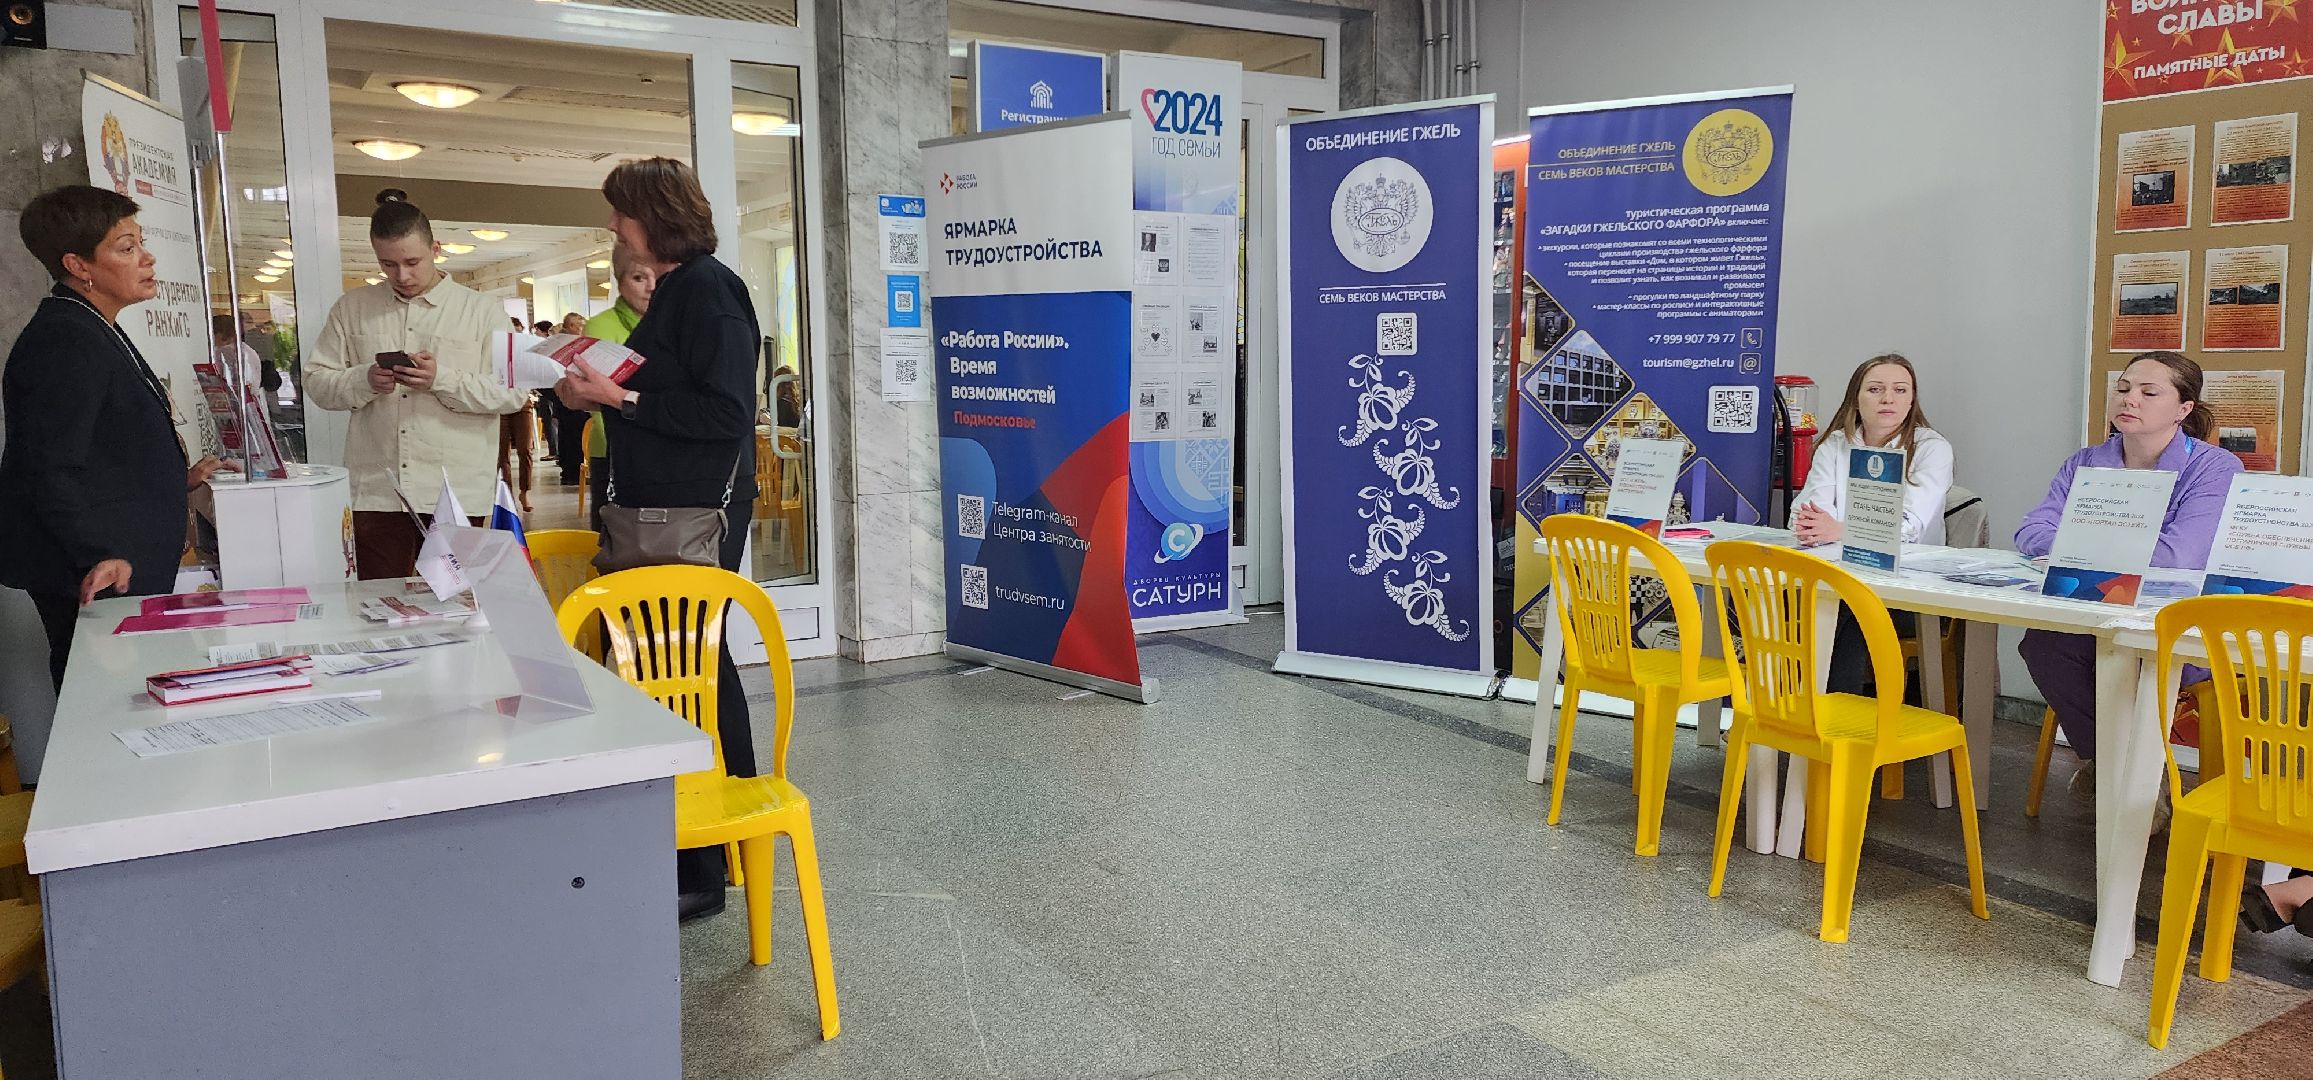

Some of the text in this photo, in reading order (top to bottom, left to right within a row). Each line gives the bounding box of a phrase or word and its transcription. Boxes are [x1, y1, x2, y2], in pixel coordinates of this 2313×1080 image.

[2157, 0, 2263, 35] СЛАВЫ
[2134, 46, 2286, 79] ПАМЯТНЫЕ ДАТЫ
[1153, 89, 1223, 136] 2024
[1306, 123, 1461, 151] ОБЪЕДИНЕНИЕ ГЖЕЛЬ
[1152, 137, 1221, 159] год семьи
[1558, 141, 1676, 159] ОБЪЕДИНЕНИЕ ГЖЕЛЬ
[1538, 162, 1675, 181] СЕМЬ ВЕКОВ МАСТЕРСТВА
[956, 181, 978, 190] РОССИИ
[1625, 203, 1770, 221] туристическая программа
[944, 217, 1018, 240] ЯРМАРКА
[1540, 223, 1591, 236] «ЗАГАДКИ
[1593, 220, 1664, 233] ГЖЕЛЬСКОГО
[1666, 217, 1726, 229] ФАРФОРА»
[945, 238, 1104, 268] ТРУДОУСТРОЙСТВА
[1319, 289, 1446, 304] СЕМЬ ВЕКОВ МАСТЕРСТВА
[941, 330, 1000, 350] «Работа
[1003, 331, 1070, 350] России».
[1648, 333, 1736, 345] +7 999 907 79 77
[950, 357, 998, 378] Время
[1642, 357, 1735, 370] tourism@gzhel.ru
[951, 385, 1057, 405] возможностей
[954, 410, 1037, 429] Подмосковье
[992, 501, 1079, 528] Telegram-канал
[993, 522, 1092, 553] Центра занятости
[1133, 572, 1221, 586] ДВОРЕЦ КУЛЬТУРЫ
[995, 585, 1066, 610] trudvsem.ru
[1132, 582, 1222, 608] САТУРН
